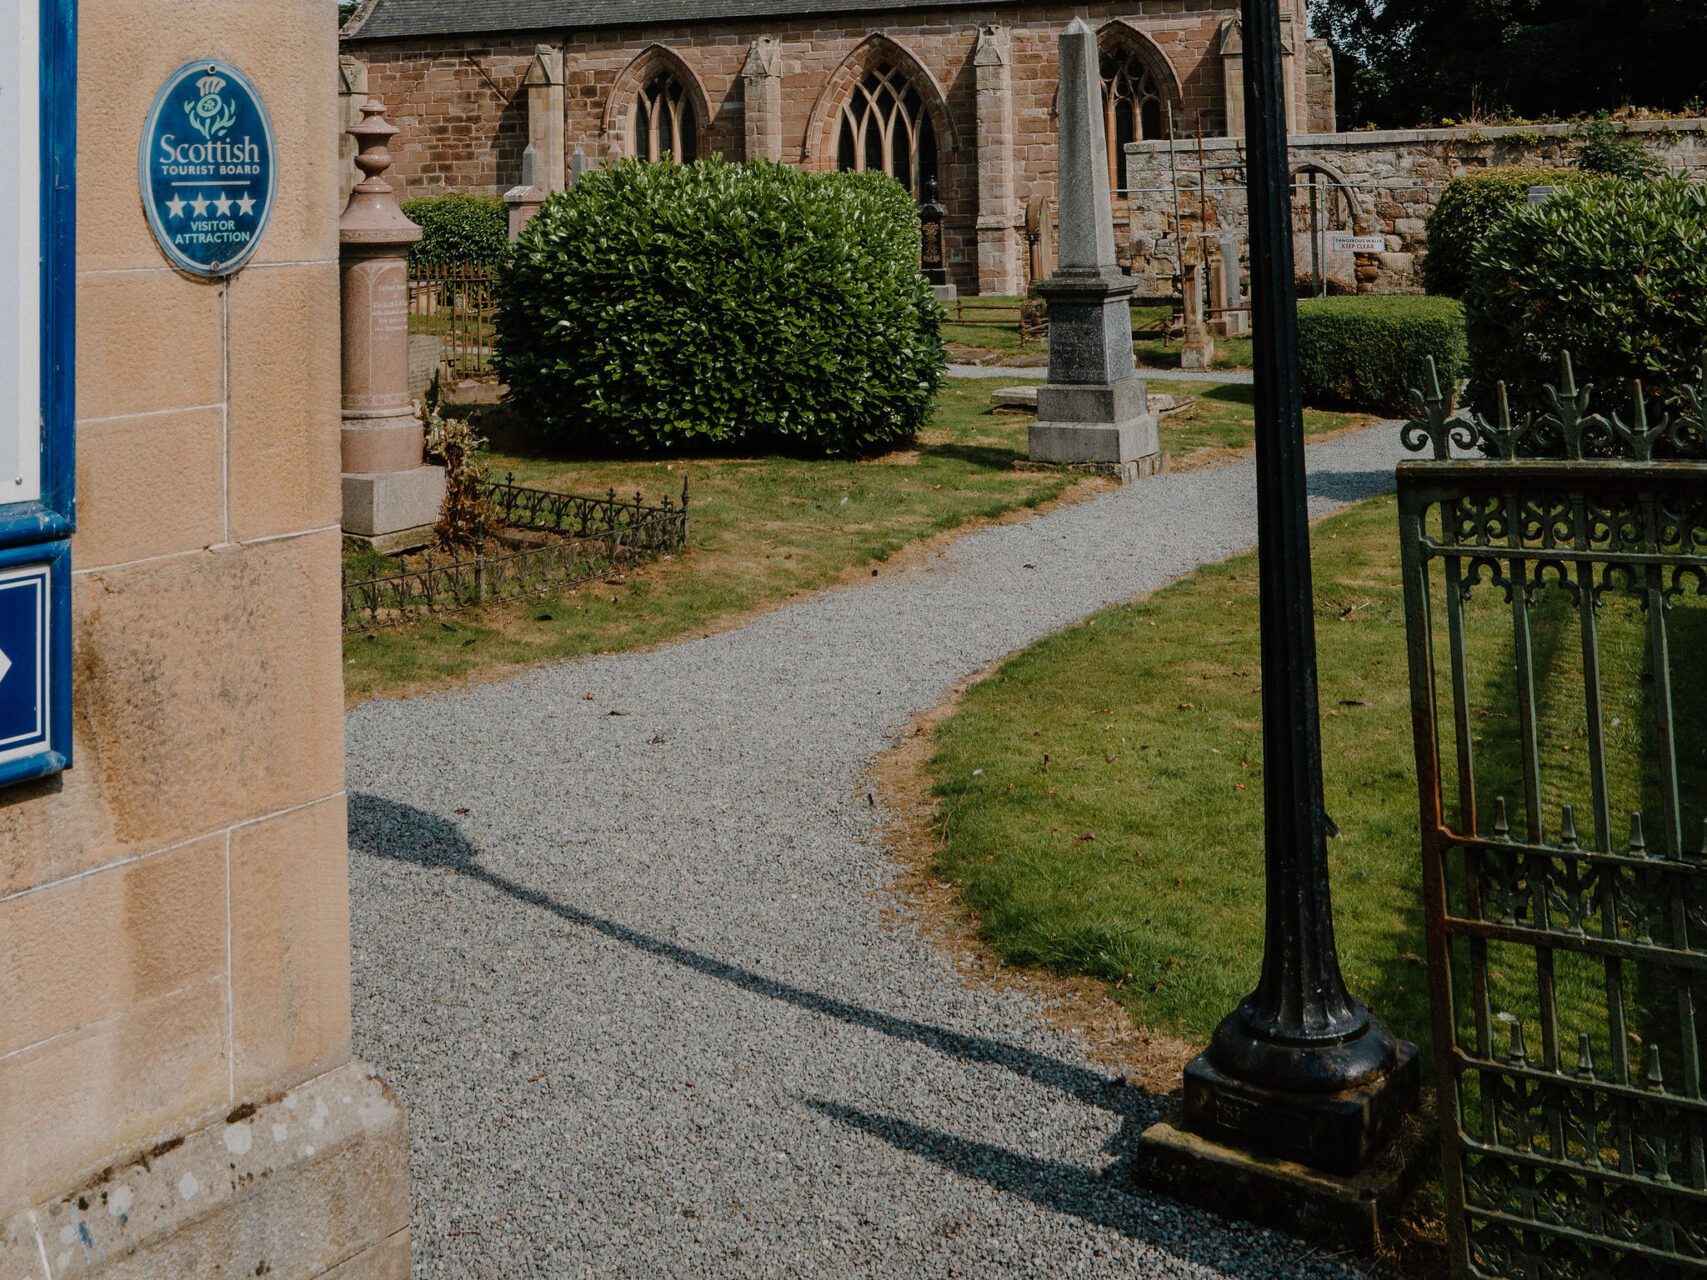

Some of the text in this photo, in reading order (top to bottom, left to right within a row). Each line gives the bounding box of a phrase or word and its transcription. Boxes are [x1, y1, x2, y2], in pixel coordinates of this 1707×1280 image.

[160, 134, 260, 163] Scottish
[161, 165, 260, 175] TOURIST BOARD
[190, 221, 235, 232] VISITOR
[175, 232, 250, 244] ATTRACTION
